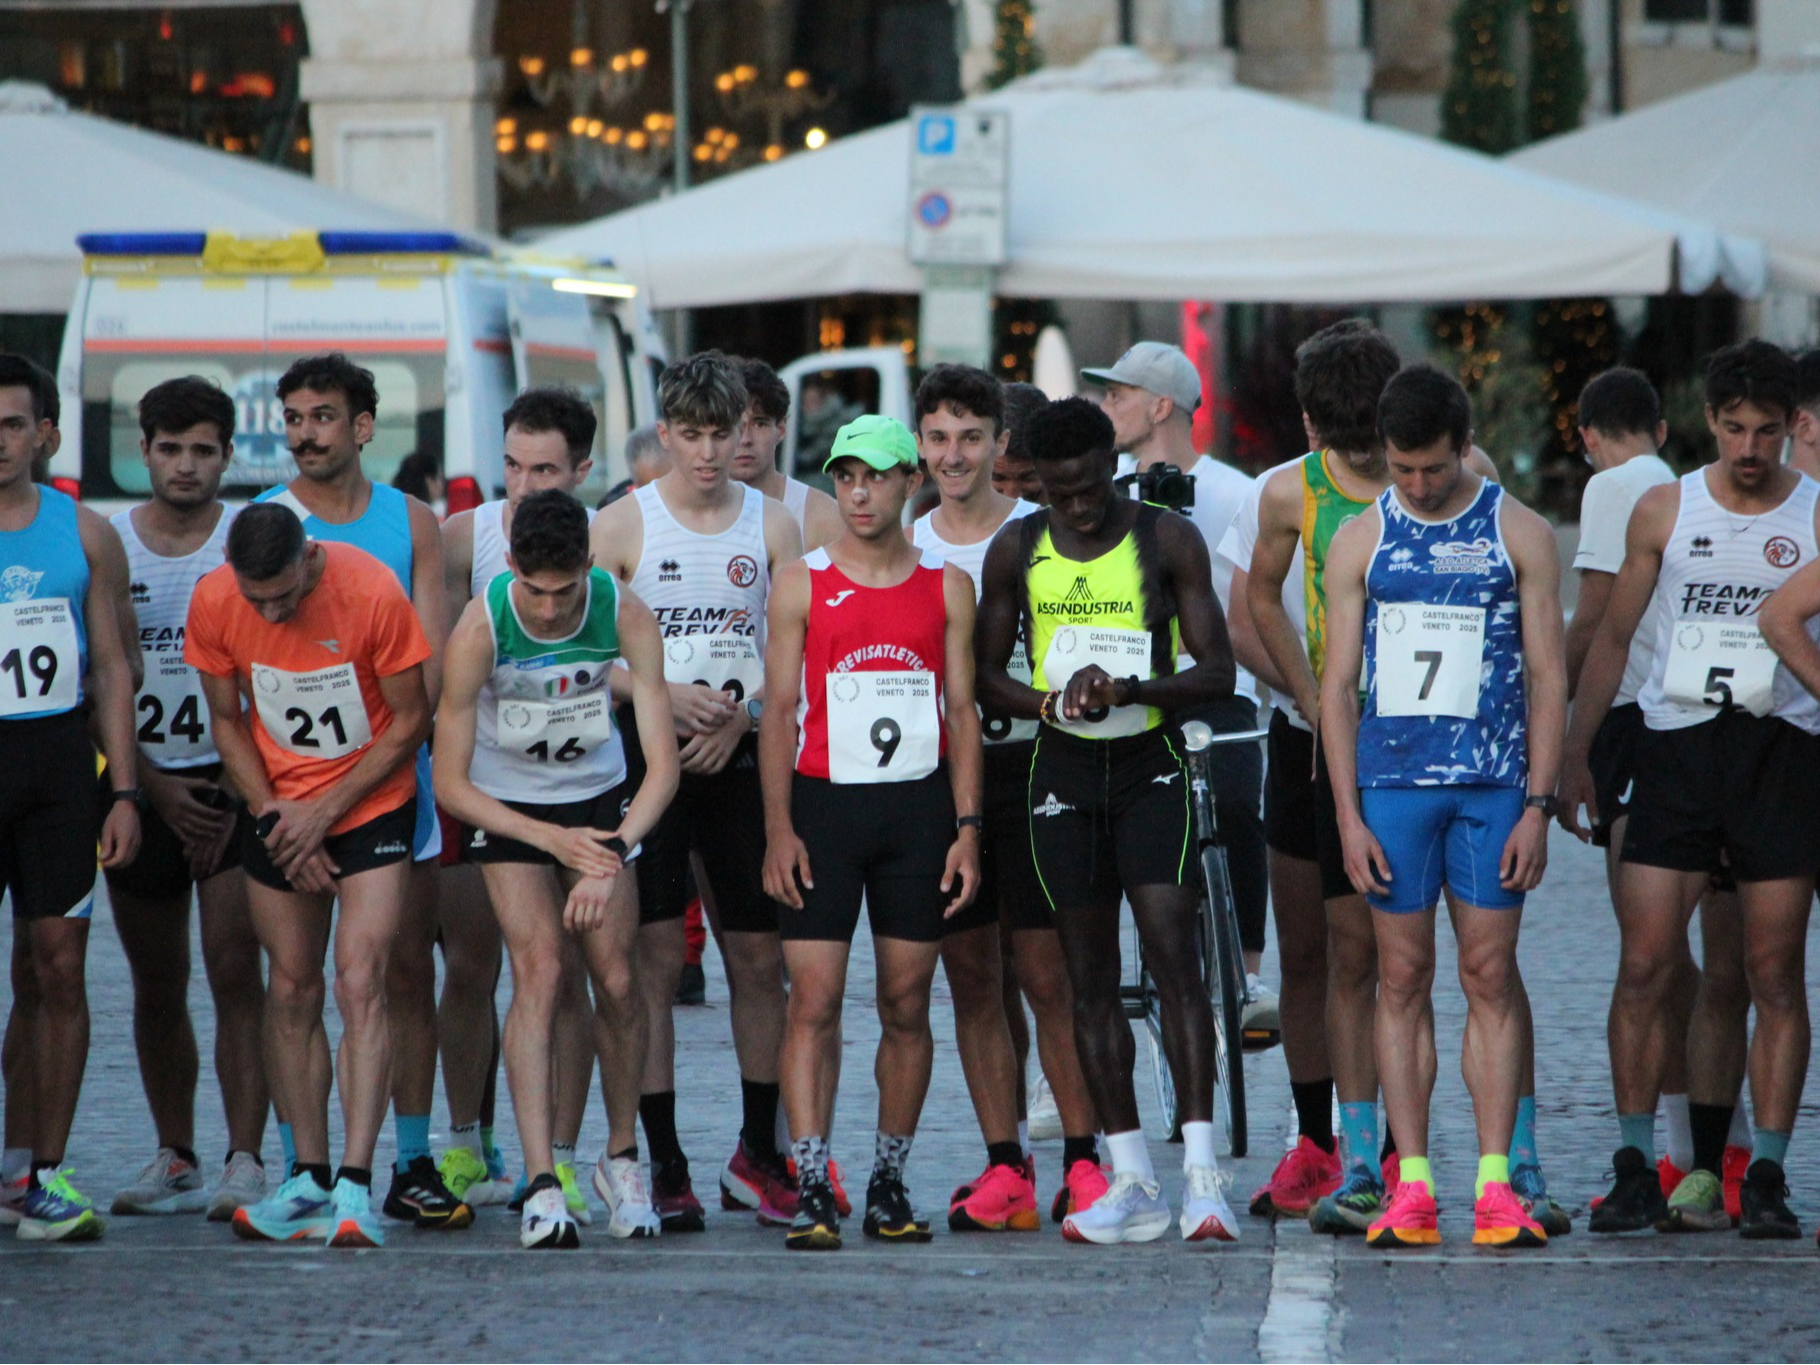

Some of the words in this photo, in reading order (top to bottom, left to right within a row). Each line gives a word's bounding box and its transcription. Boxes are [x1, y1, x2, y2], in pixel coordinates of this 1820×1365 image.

[237, 399, 286, 434] 118
[659, 574, 682, 582] errea
[1684, 583, 1763, 600] TEAM
[14, 605, 65, 617] CASTELFRANCO
[1038, 601, 1134, 615] ASSINDUSTRIA
[1681, 597, 1752, 617] TREV
[653, 607, 728, 622] TEAM
[1068, 616, 1093, 624] SPORT
[1422, 612, 1480, 622] CASTELFRANCO
[16, 617, 44, 627] VENETO
[1422, 622, 1450, 631] VENETO
[1459, 625, 1478, 633] 2025
[1090, 633, 1146, 646] CASTELFRANCO
[1719, 641, 1748, 649] VENETO
[710, 651, 736, 659] VENETO
[1090, 644, 1118, 654] VENETO
[1126, 647, 1145, 656] 2025
[0, 645, 58, 698] 19
[160, 667, 188, 676] VENETO
[292, 669, 350, 685] CASTELFRANCO
[1414, 651, 1443, 700] 7
[295, 685, 325, 693] VENETO
[331, 679, 352, 690] 2025
[876, 678, 930, 686] CASTELFRANCO
[1703, 666, 1735, 708] 5
[876, 688, 905, 696] VENETO
[912, 689, 930, 697] 2025
[546, 700, 602, 717] CASTELFRANCO
[583, 709, 602, 720] 2025
[137, 694, 205, 744] 24
[285, 706, 348, 748] 21
[870, 717, 902, 768] 9
[525, 737, 586, 764] 16
